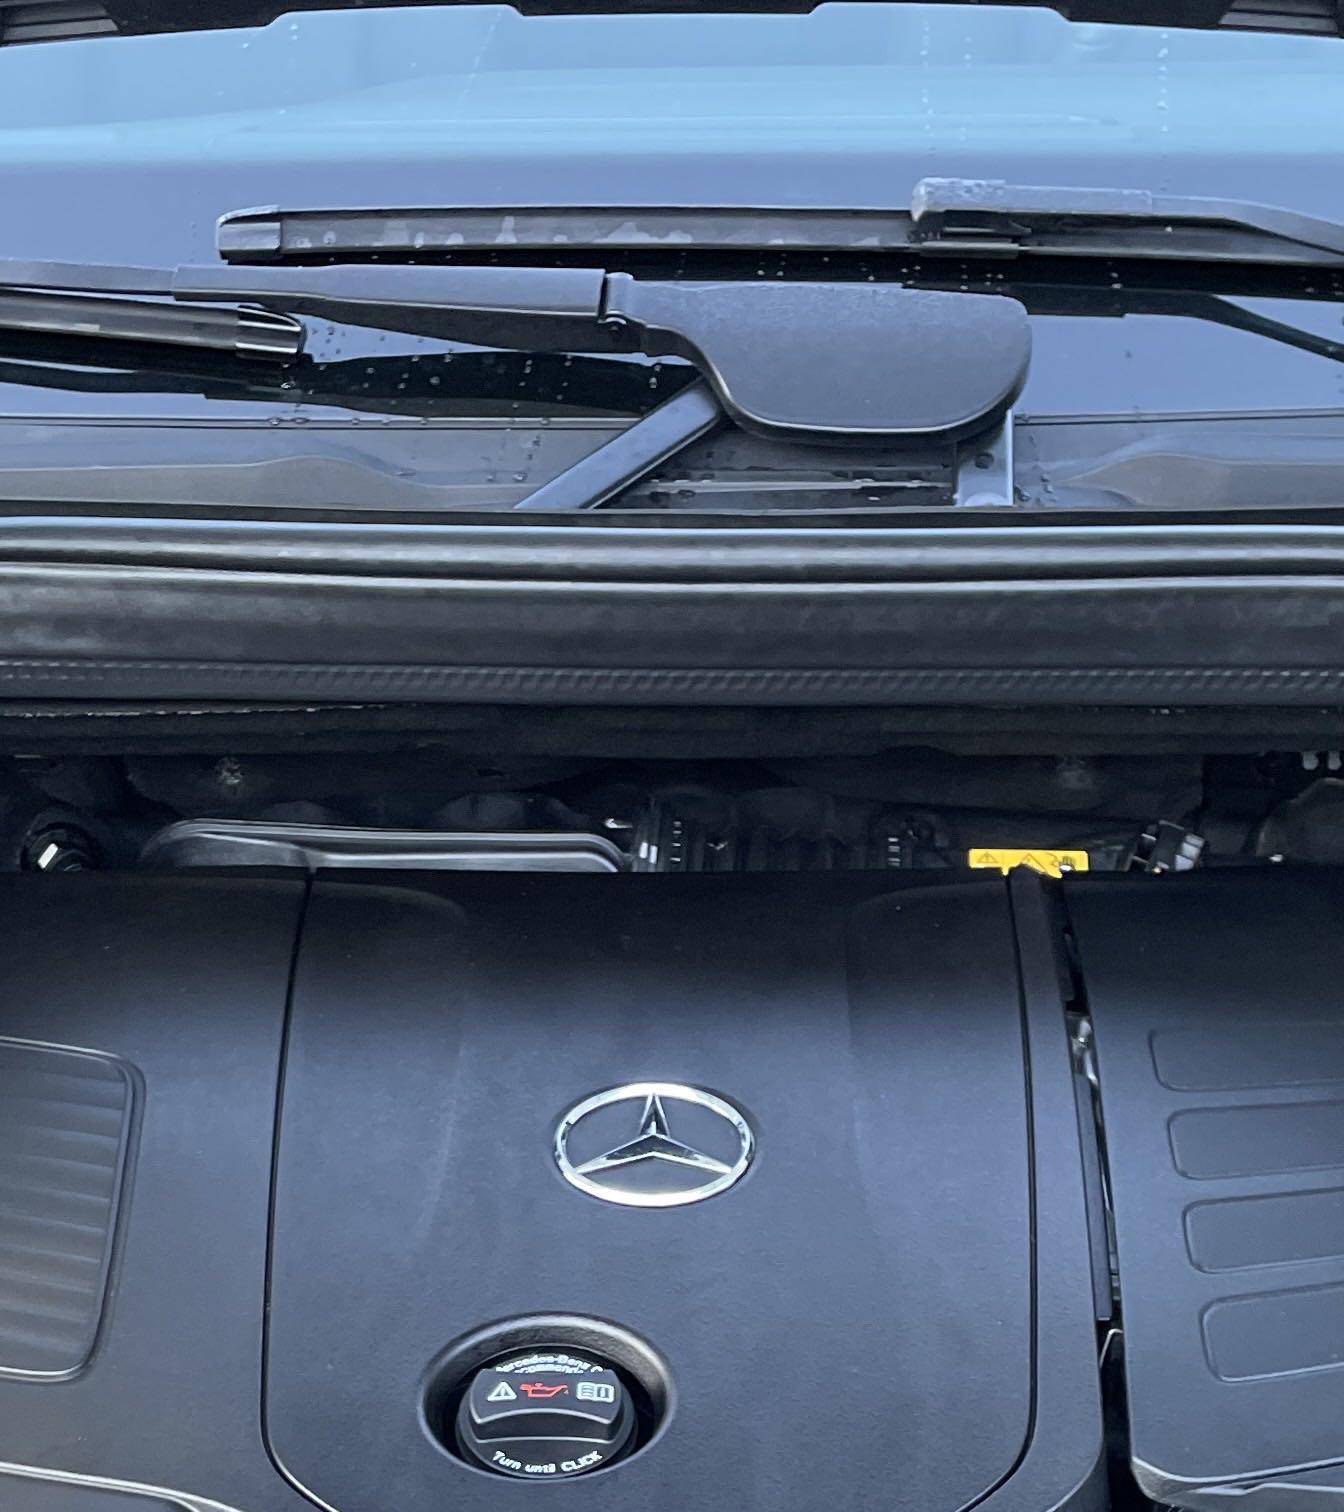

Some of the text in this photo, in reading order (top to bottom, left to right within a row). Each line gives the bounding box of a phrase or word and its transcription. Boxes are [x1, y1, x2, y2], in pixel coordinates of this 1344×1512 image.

[492, 1450, 603, 1474] Turn until CLICK
